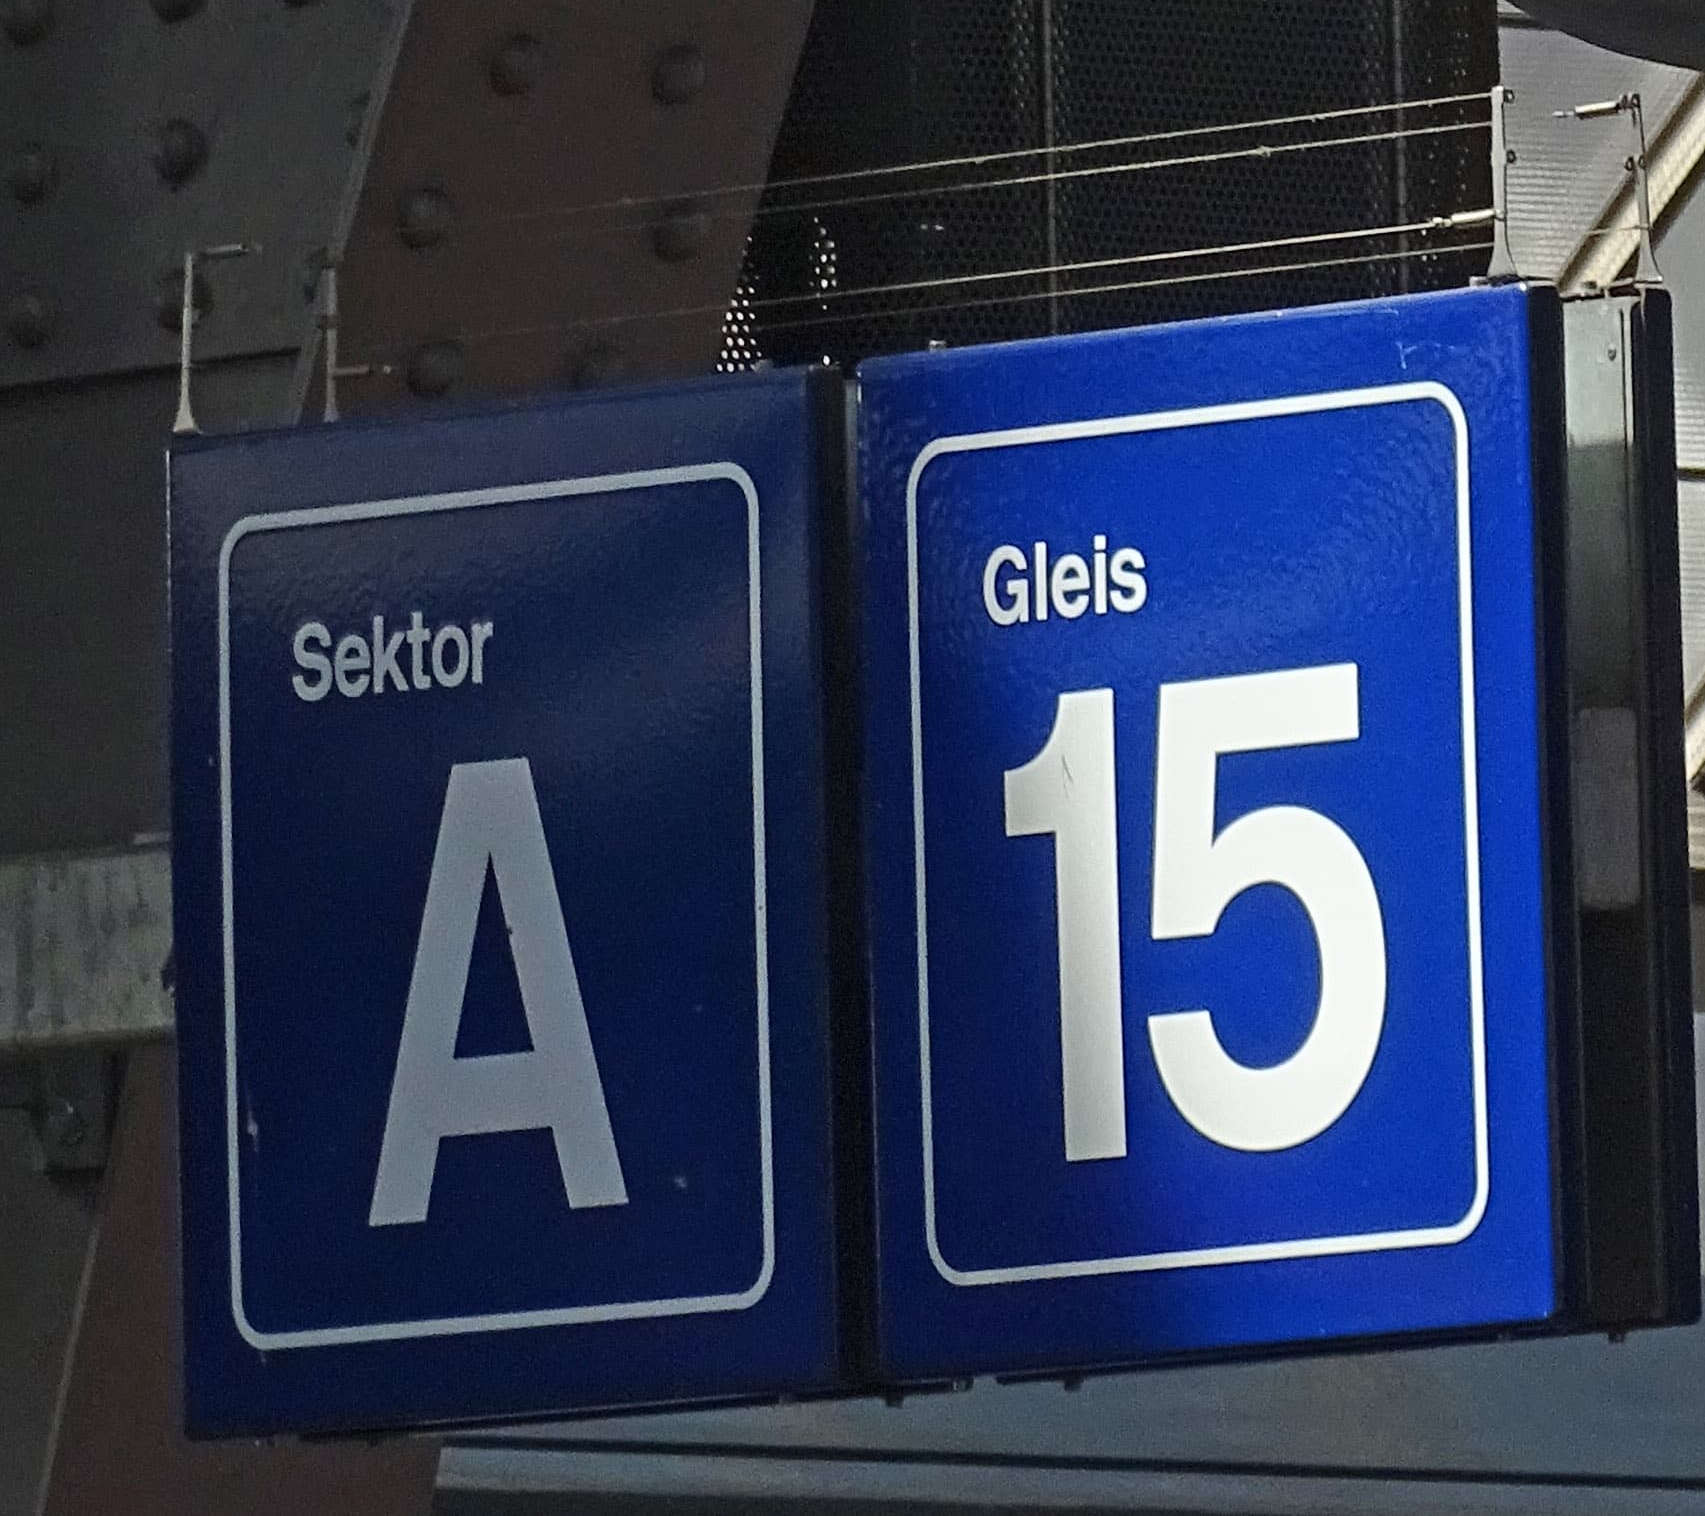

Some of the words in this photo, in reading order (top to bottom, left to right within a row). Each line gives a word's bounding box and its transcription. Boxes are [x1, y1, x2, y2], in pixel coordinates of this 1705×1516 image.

[289, 610, 496, 703] Sektor
[981, 533, 1148, 627] Gleis
[367, 755, 631, 1228] A
[1001, 661, 1388, 1163] 15
